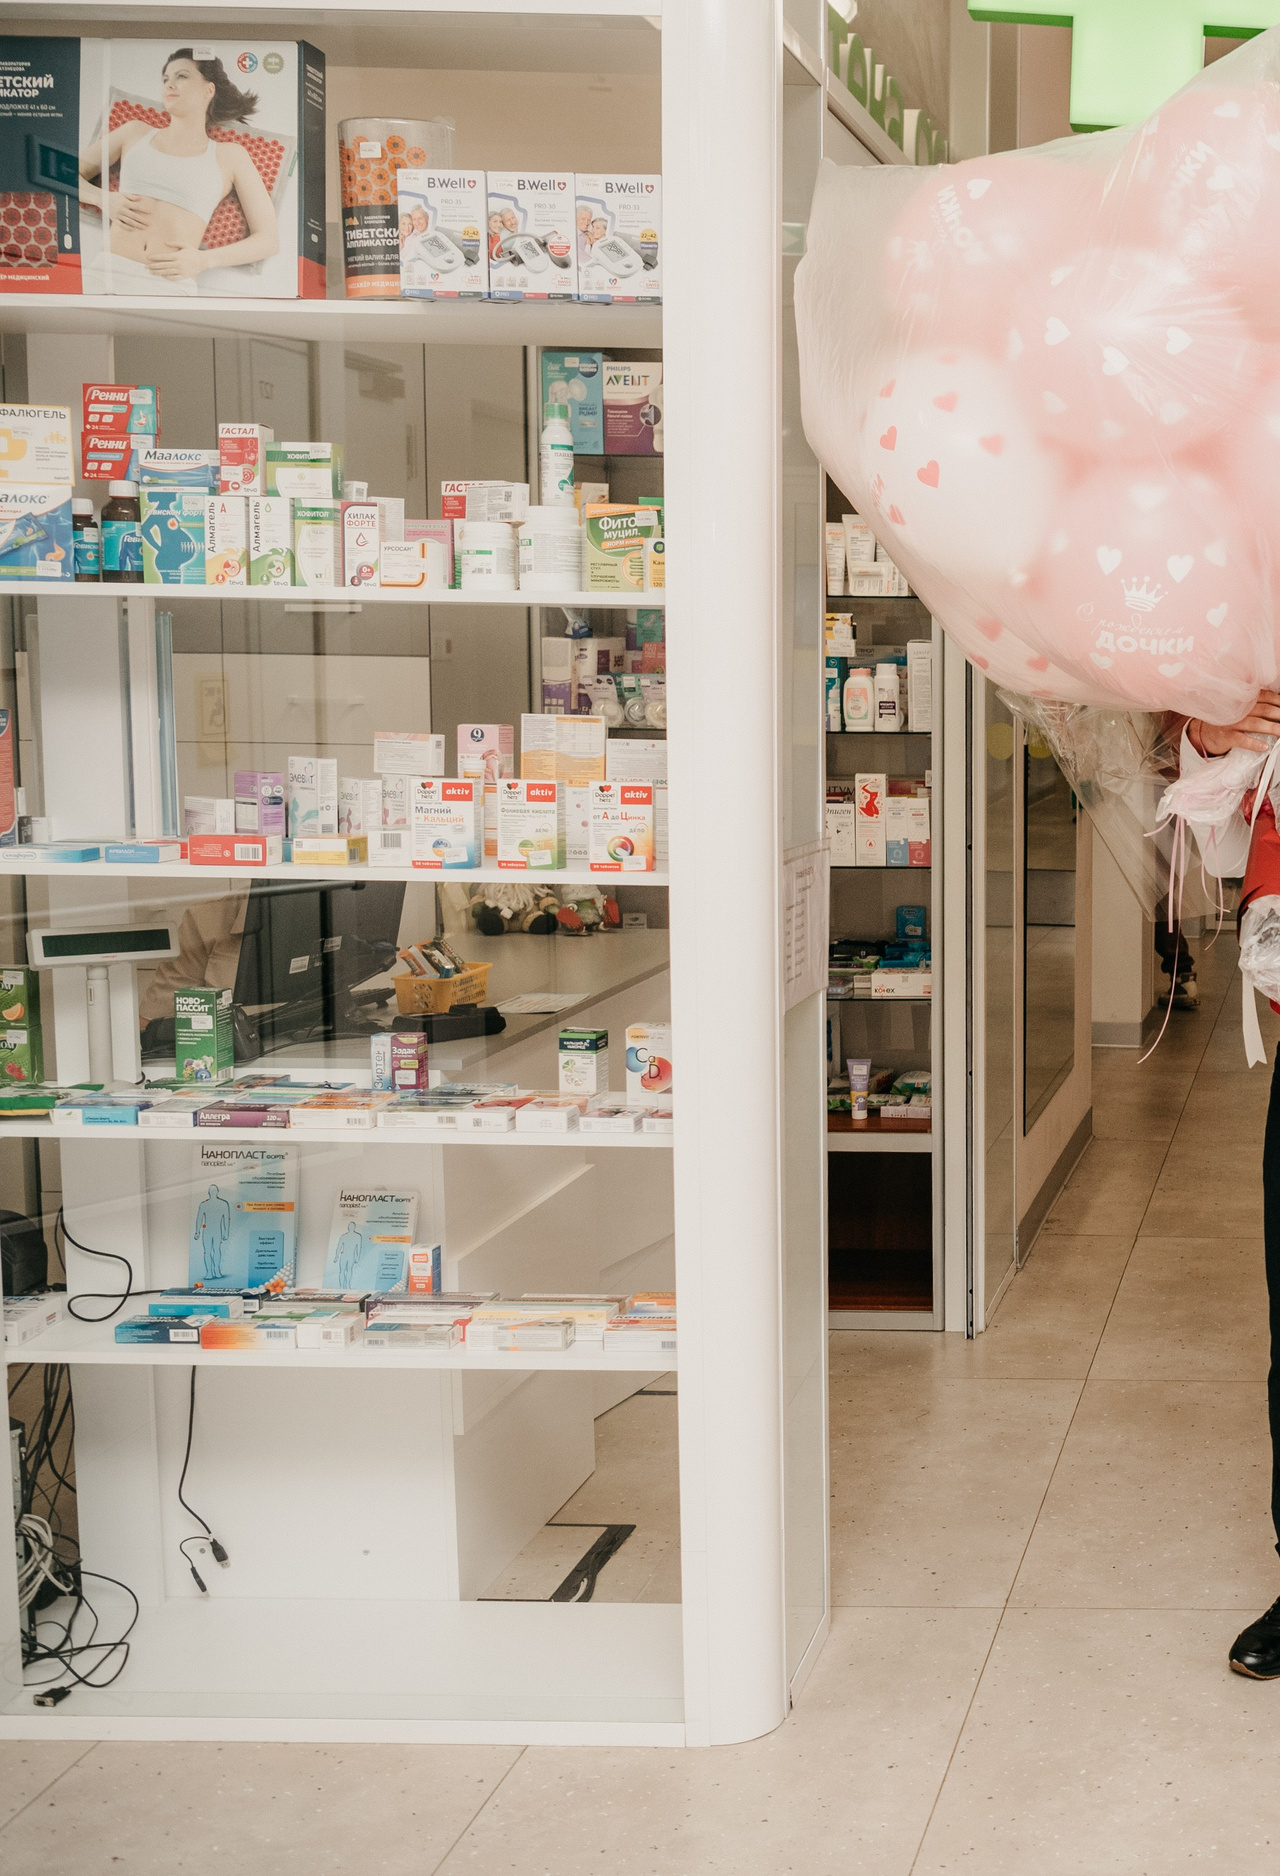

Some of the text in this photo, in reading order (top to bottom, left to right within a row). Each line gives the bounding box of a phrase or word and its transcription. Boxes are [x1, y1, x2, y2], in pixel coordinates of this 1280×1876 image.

[427, 177, 466, 189] B.Well
[517, 179, 556, 191] B.Well
[605, 182, 644, 194] B.Well
[346, 228, 400, 241] ТИБЕТСКИ
[91, 389, 128, 402] Ренни
[221, 426, 255, 435] ГАСТАЛ
[90, 437, 127, 450] Ренни
[144, 450, 201, 462] Маалокс
[444, 483, 478, 493] ГАСТ
[296, 510, 330, 518] ХОФИТОЛ
[347, 512, 376, 520] ХИЛАК
[208, 501, 216, 553] Алмагель
[253, 501, 261, 553] Алмагель
[123, 534, 143, 543] Геви
[1095, 629, 1194, 655] ДОЧКИ
[445, 787, 470, 796] aktiv
[530, 788, 553, 797] aktiv
[624, 790, 648, 799] aktiv
[415, 805, 452, 814] Магний
[424, 814, 464, 824] Кальций
[602, 811, 609, 820] А
[176, 1004, 209, 1012] ПАССИТ
[392, 1046, 417, 1054] Зодак
[200, 1112, 230, 1121] Аллегра
